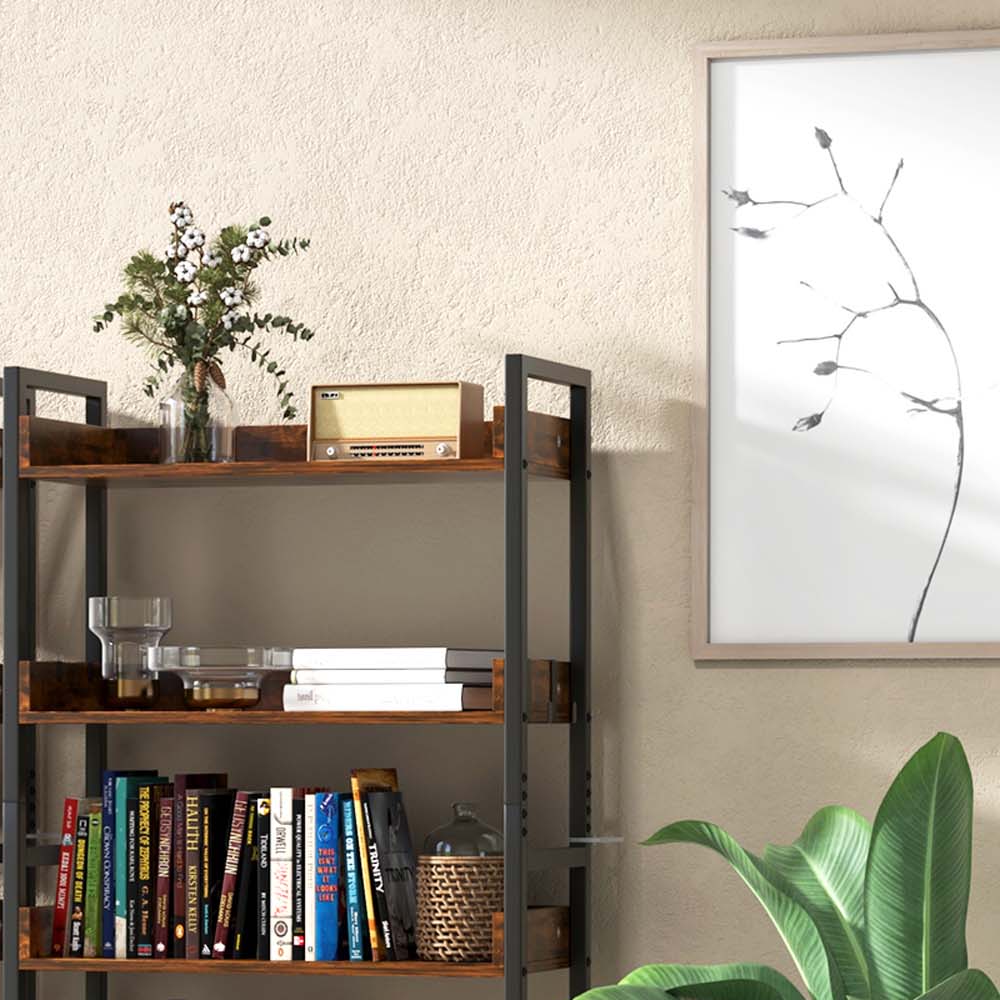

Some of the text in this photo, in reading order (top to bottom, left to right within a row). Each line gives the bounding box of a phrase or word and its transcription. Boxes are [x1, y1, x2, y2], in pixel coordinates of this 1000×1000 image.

[139, 786, 149, 799] THE
[139, 800, 149, 835] PROPHECY
[186, 796, 199, 851] HALITH
[139, 837, 149, 845] OF
[158, 806, 172, 877] GEOSYNCHRON
[224, 799, 248, 876] GEOSYNCHRON
[275, 827, 287, 854] ORWELL
[345, 837, 354, 850] ON
[346, 852, 356, 871] THE
[368, 843, 384, 893] TRINITY
[187, 866, 197, 933] KIRSTEN KELLY
[347, 872, 358, 904] STORM
